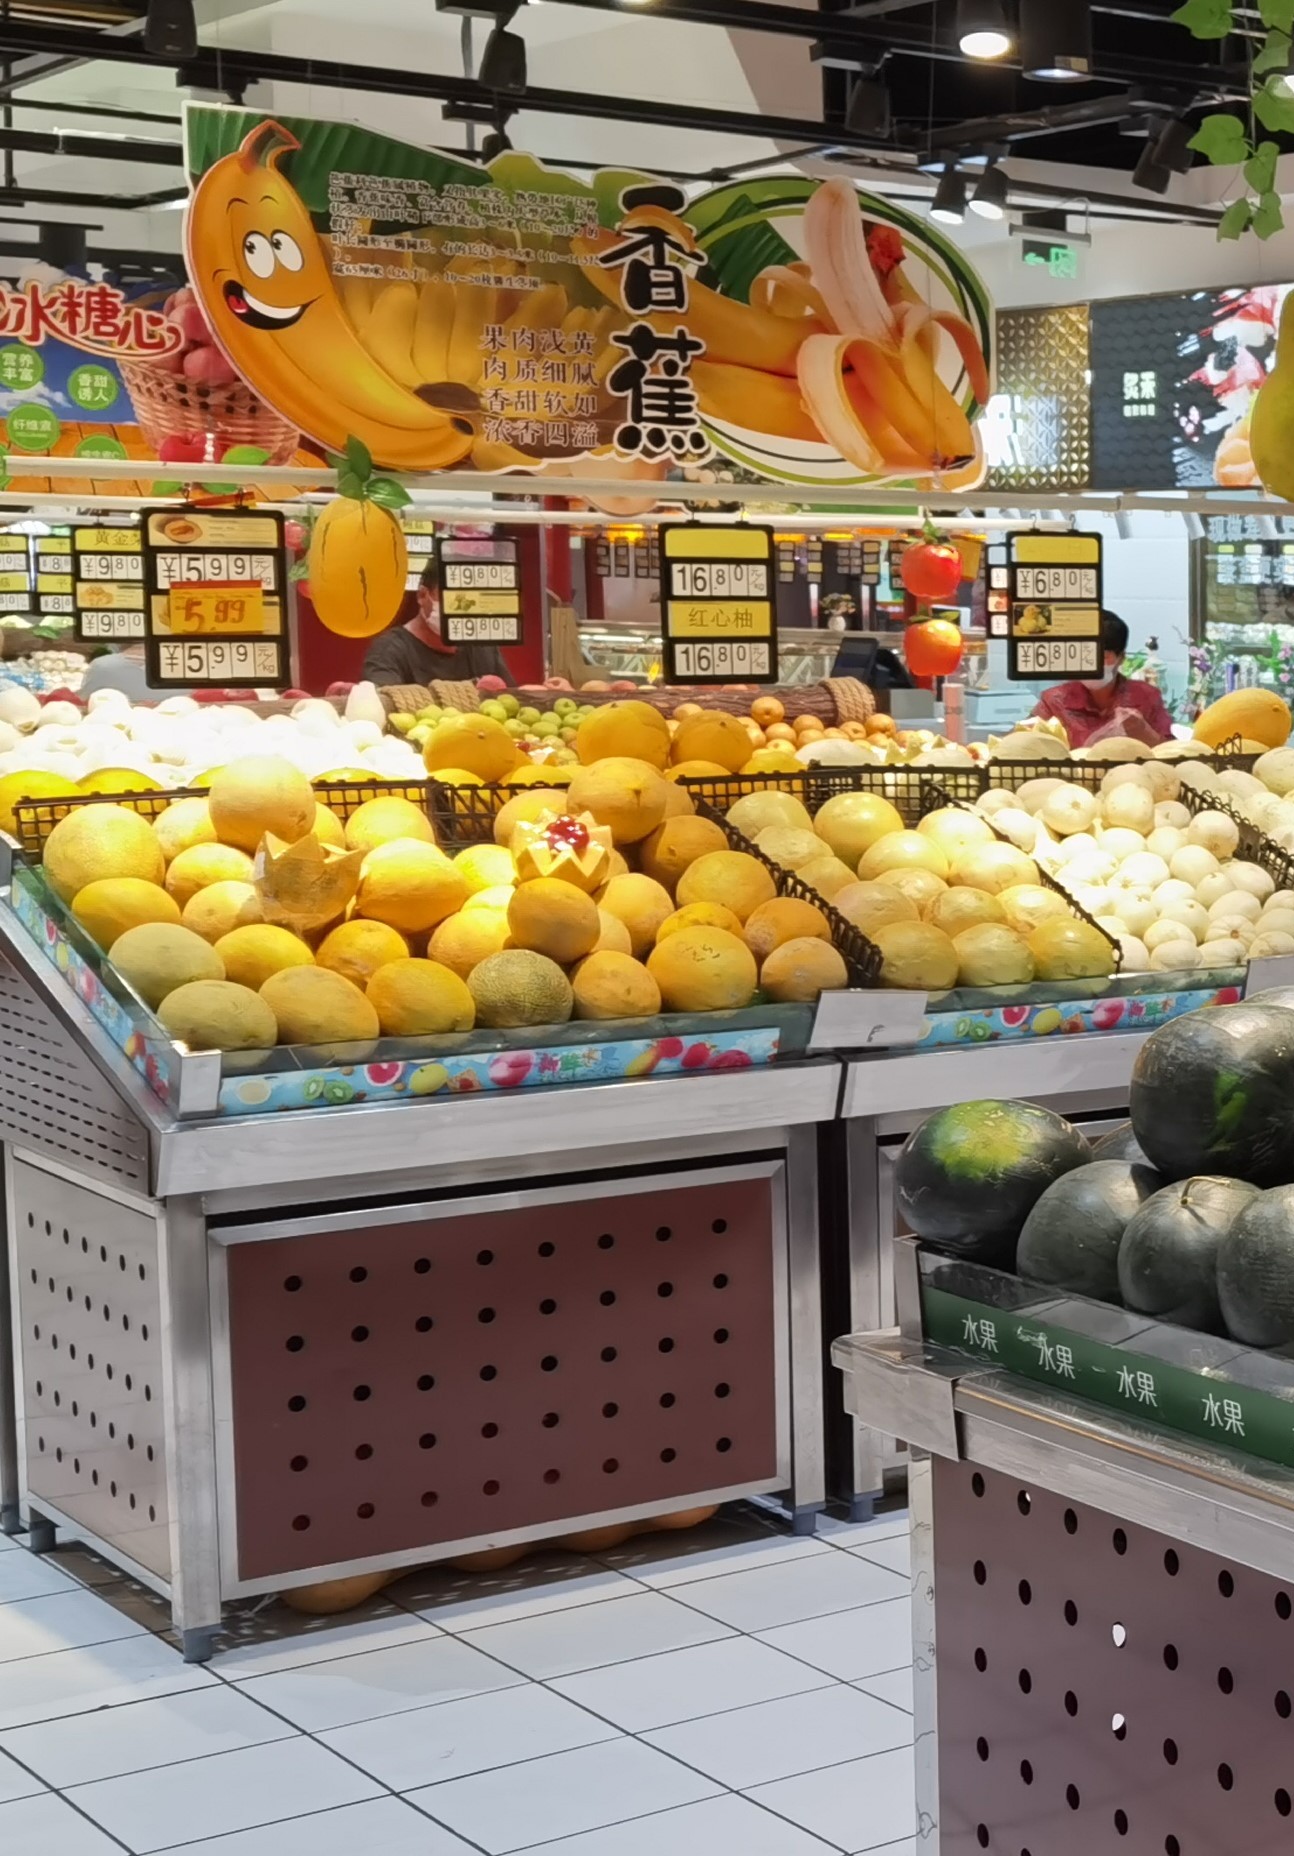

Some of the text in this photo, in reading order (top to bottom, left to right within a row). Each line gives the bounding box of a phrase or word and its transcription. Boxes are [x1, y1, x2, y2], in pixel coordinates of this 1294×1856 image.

[600, 186, 706, 452] 香蕉
[481, 325, 595, 356] 果肉浅黄
[484, 356, 599, 387] 肉质细腻
[688, 607, 753, 629] 红心柚
[961, 1313, 999, 1354] 水果
[1036, 1337, 1077, 1381] 水果
[1116, 1365, 1158, 1408] 水果
[1201, 1392, 1246, 1437] 水果
